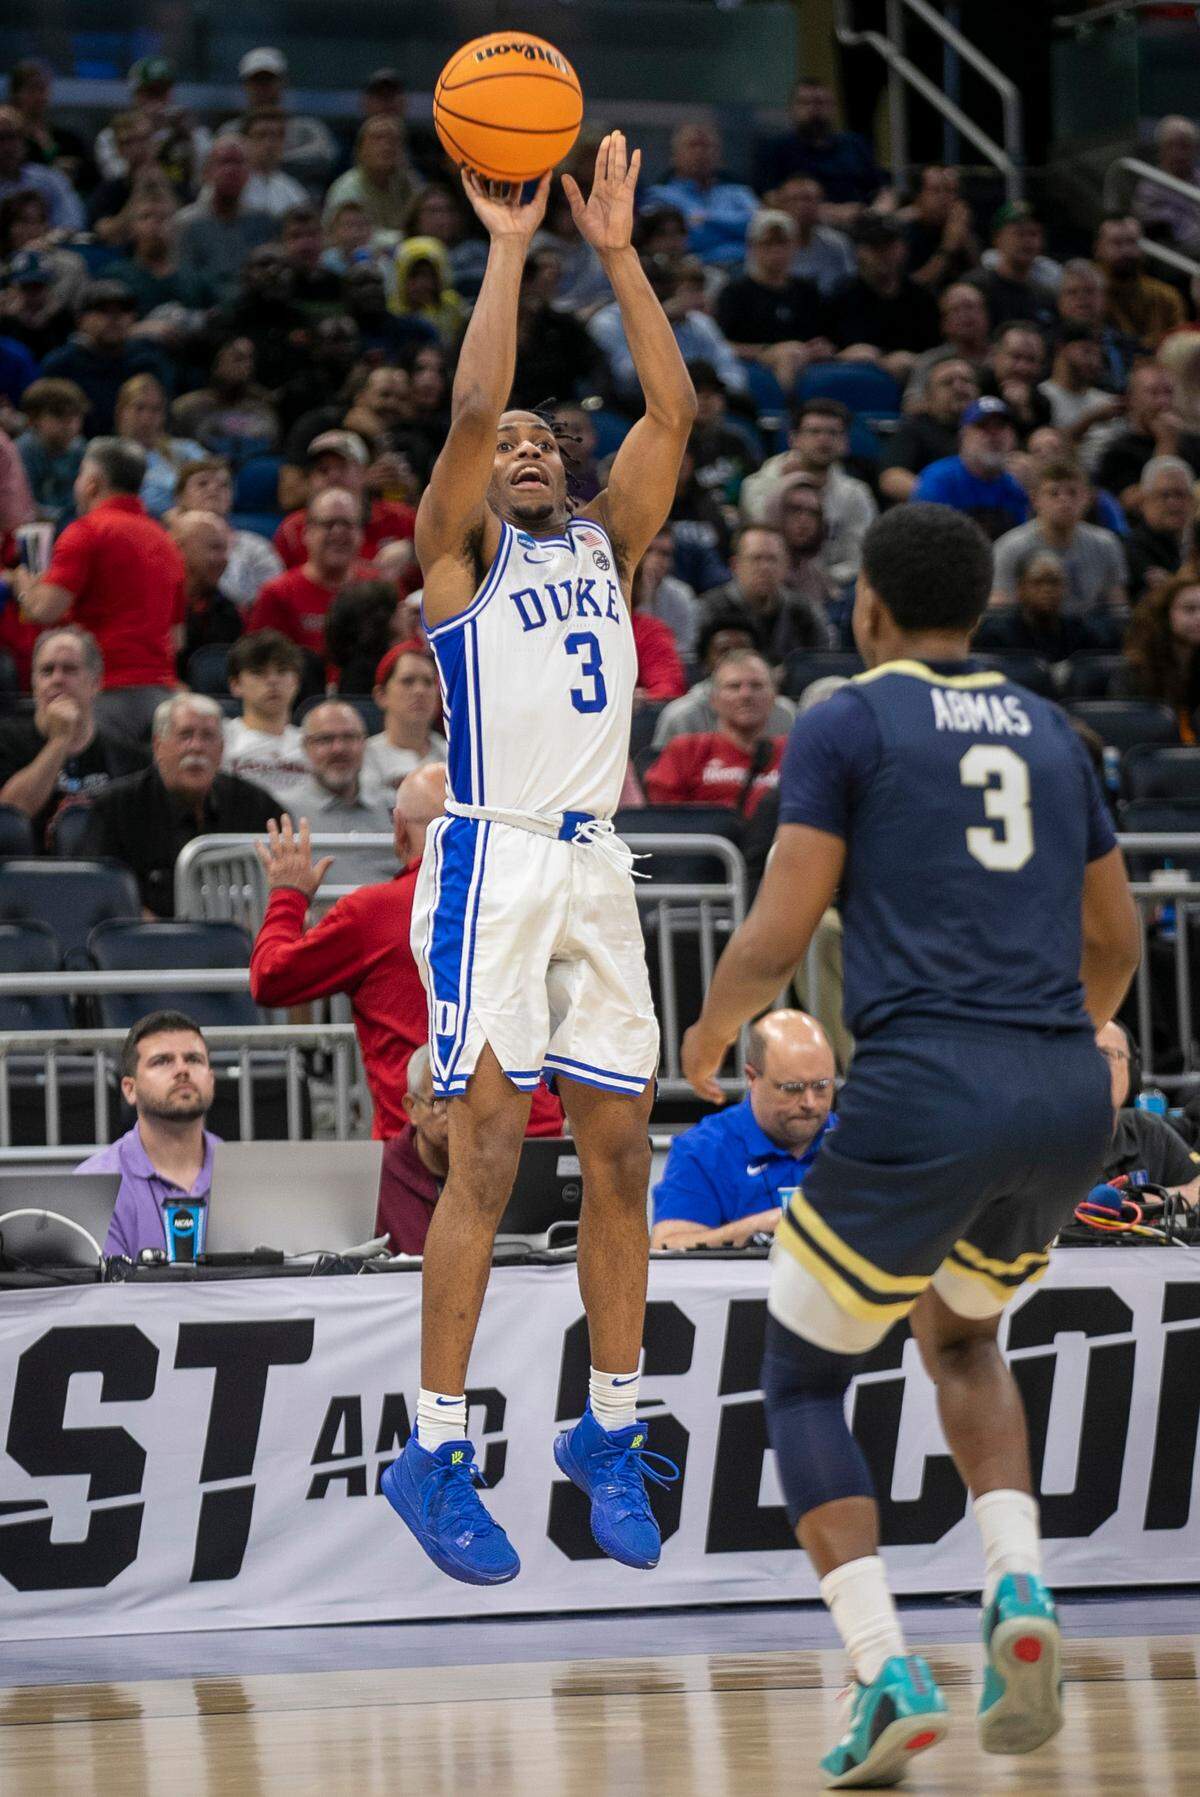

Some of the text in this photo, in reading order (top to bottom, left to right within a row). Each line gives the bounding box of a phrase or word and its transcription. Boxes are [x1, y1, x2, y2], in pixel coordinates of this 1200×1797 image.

[473, 42, 571, 76] Wilson
[509, 577, 620, 632] DUKE
[564, 631, 608, 714] 3
[930, 687, 1033, 737] ABMAS
[959, 744, 1035, 872] 3
[174, 1218, 194, 1228] NCAA
